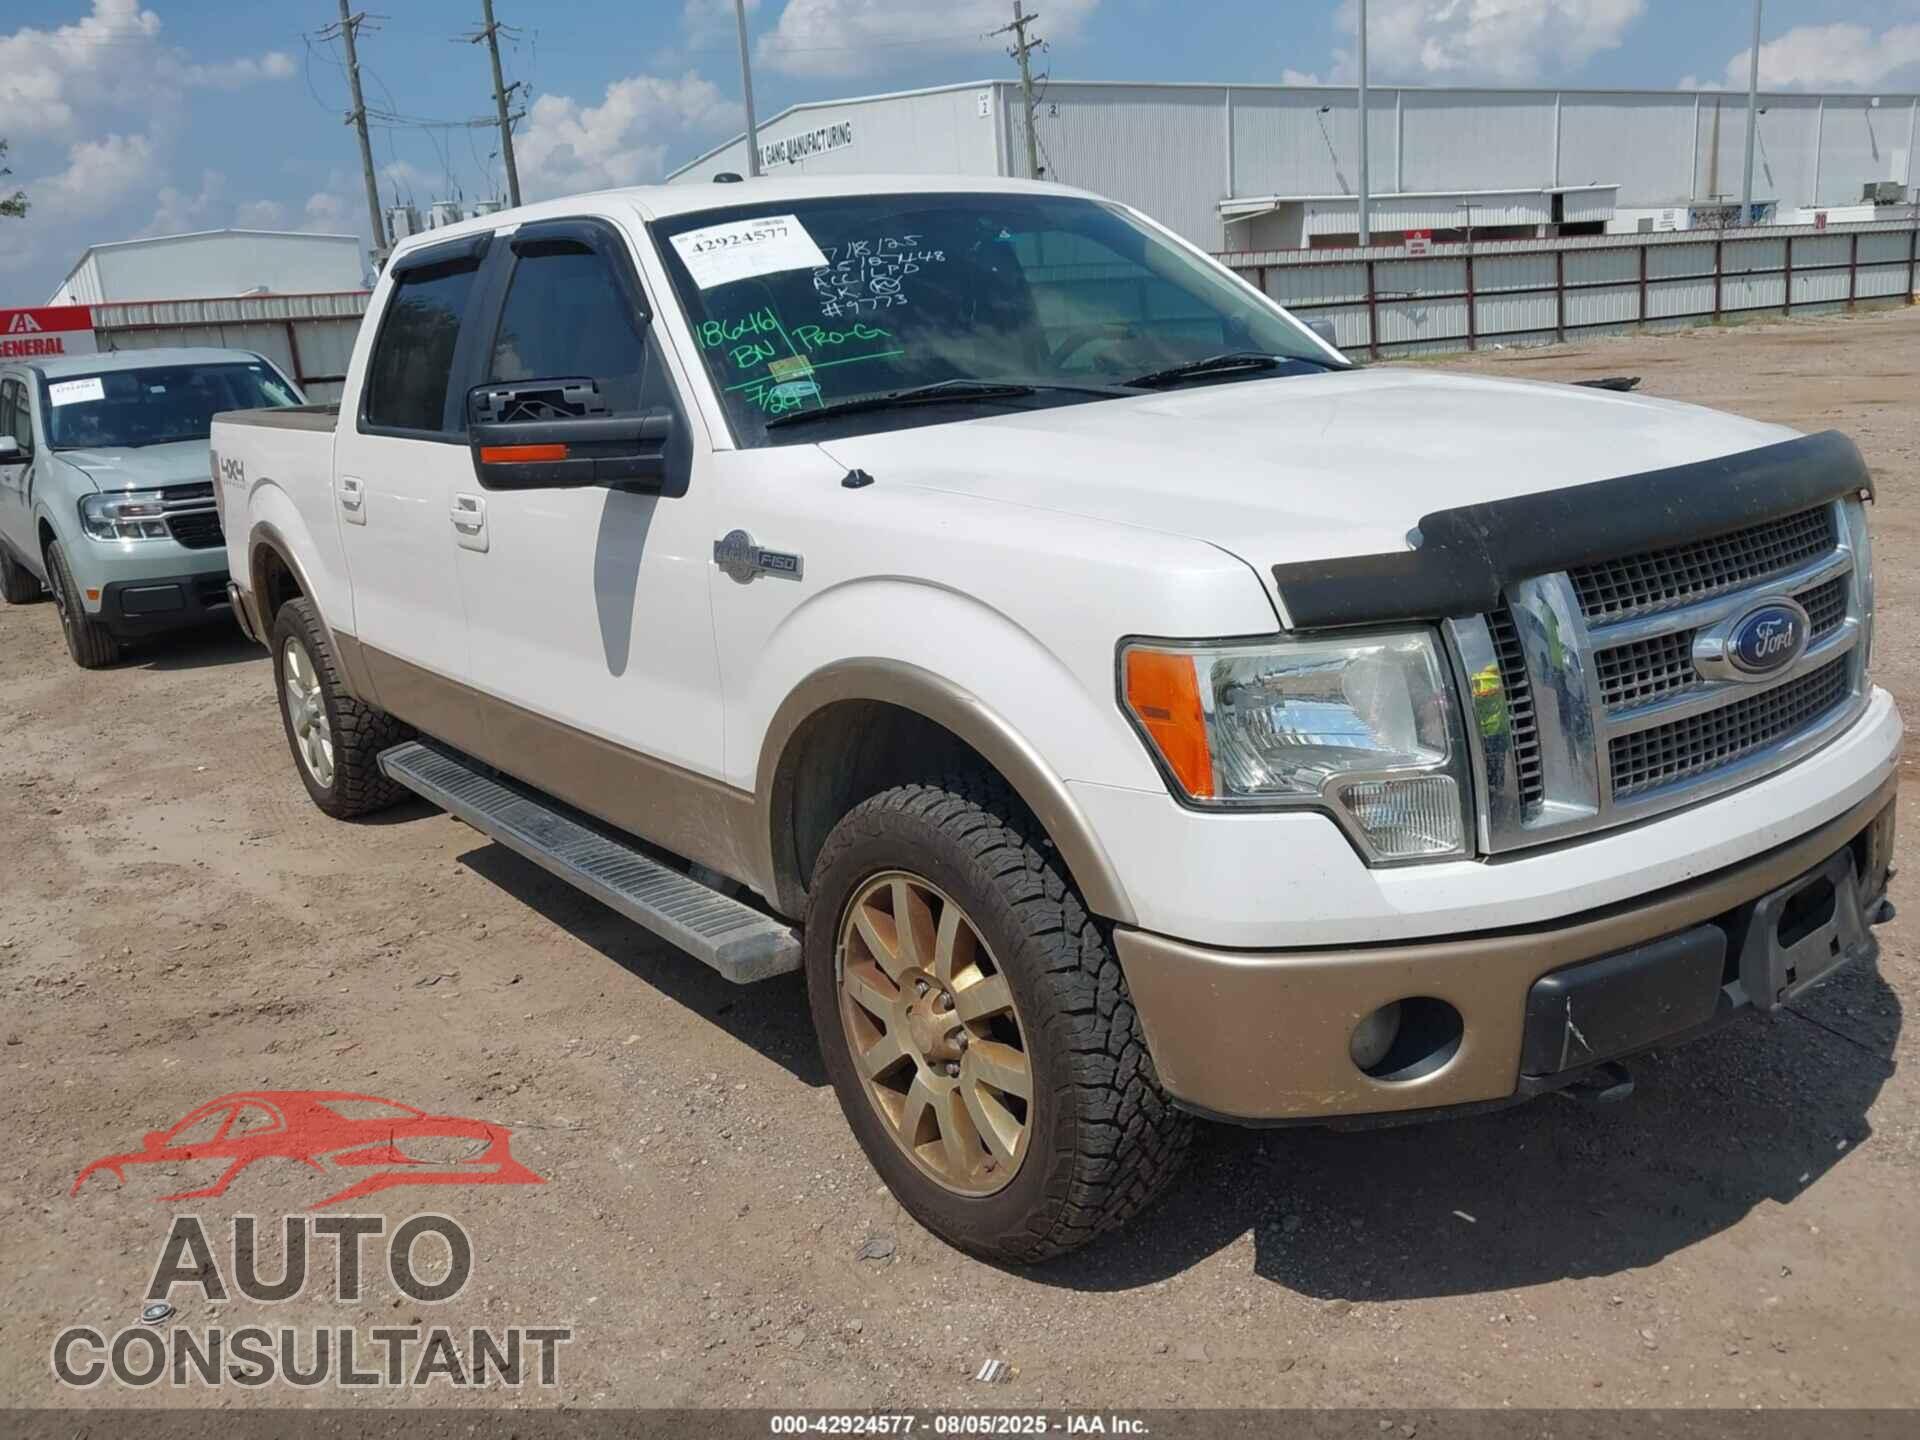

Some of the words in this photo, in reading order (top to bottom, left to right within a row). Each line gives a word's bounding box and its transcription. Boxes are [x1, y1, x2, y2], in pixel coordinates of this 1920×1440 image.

[786, 122, 851, 159] MANUFACTURING
[692, 226, 789, 253] 42924577
[0, 338, 65, 357] ENERAL
[1755, 617, 1794, 659] Ford
